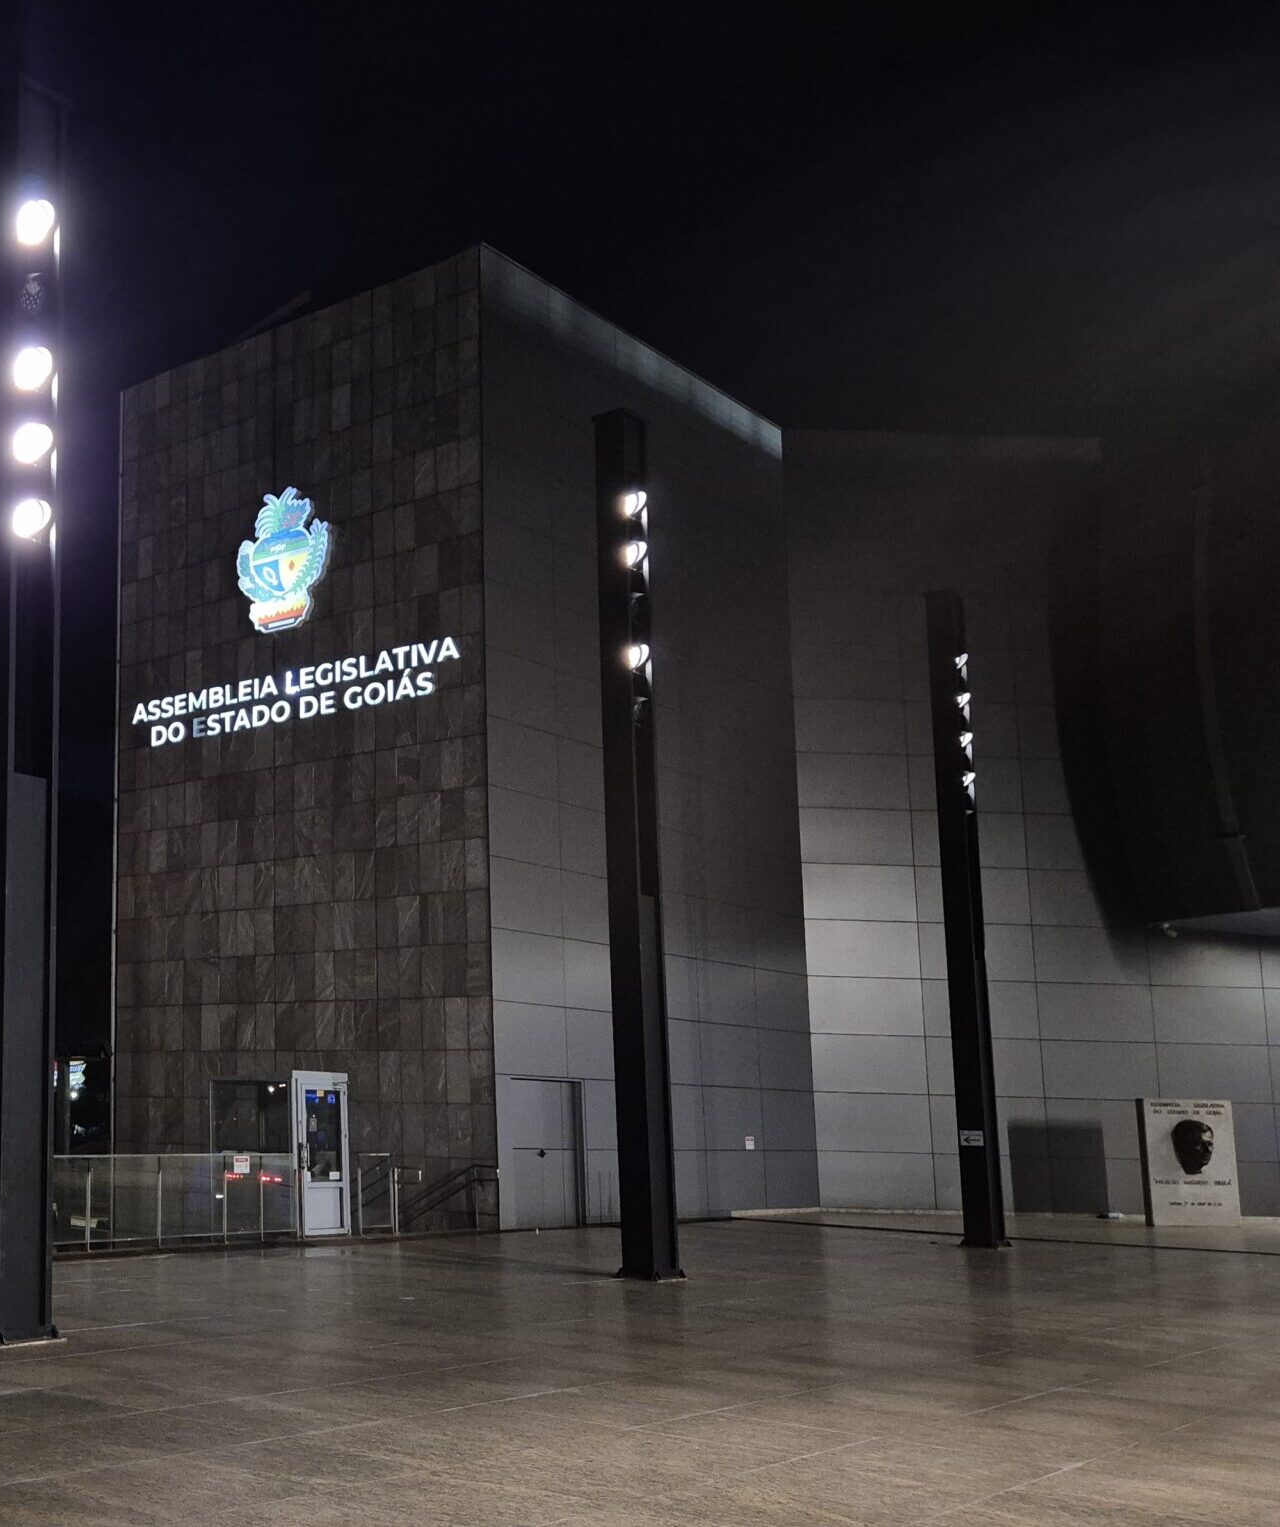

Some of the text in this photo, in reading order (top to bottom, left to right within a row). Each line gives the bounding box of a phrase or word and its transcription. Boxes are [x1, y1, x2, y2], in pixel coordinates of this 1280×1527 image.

[131, 636, 462, 725] ASSEMBLEIA LEGISLATIVA
[150, 667, 438, 748] DO ESTADO DE GOIÁS
